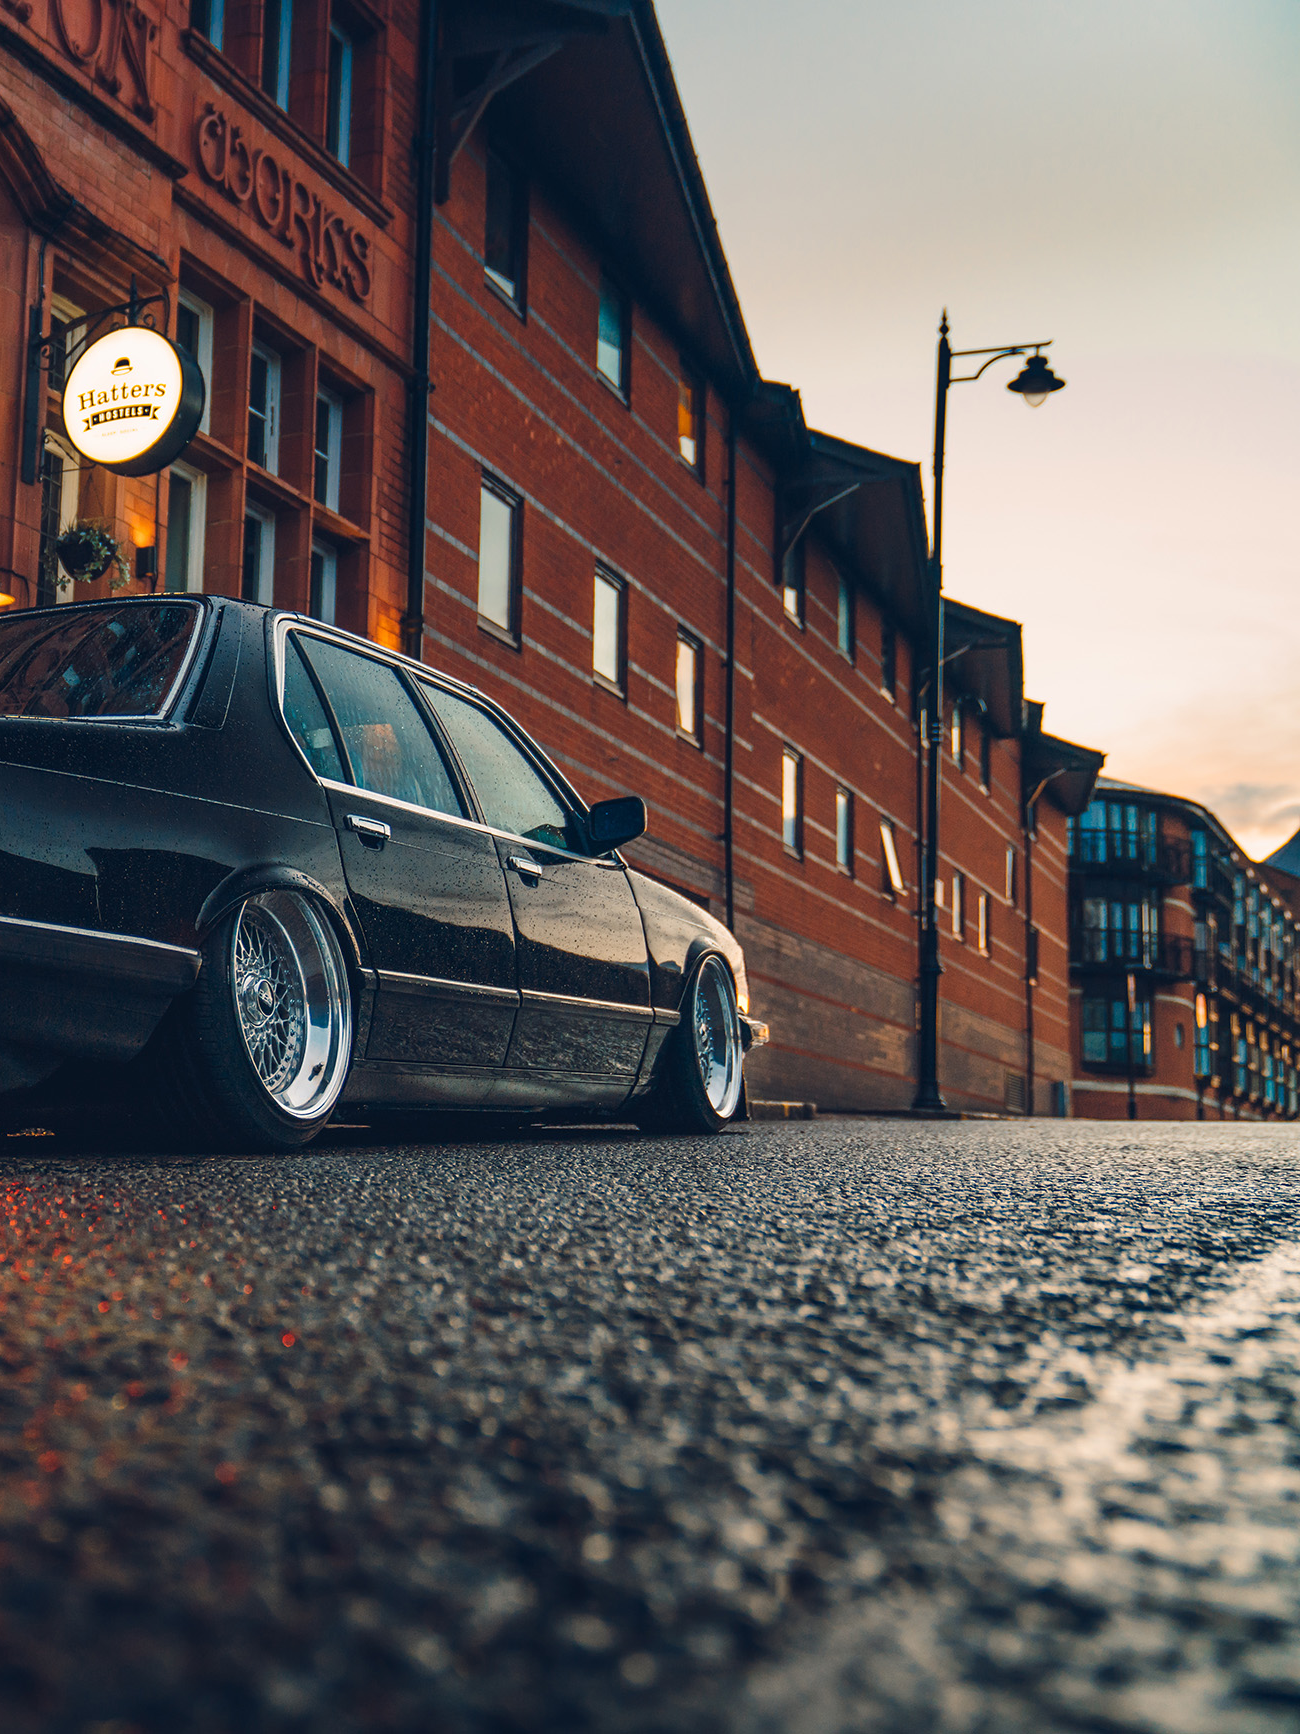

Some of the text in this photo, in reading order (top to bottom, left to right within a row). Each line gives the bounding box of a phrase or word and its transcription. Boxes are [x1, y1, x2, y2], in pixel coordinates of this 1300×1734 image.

[1, 0, 156, 125] ON
[77, 382, 166, 411] Hatters
[98, 406, 144, 422] HOSTELS
